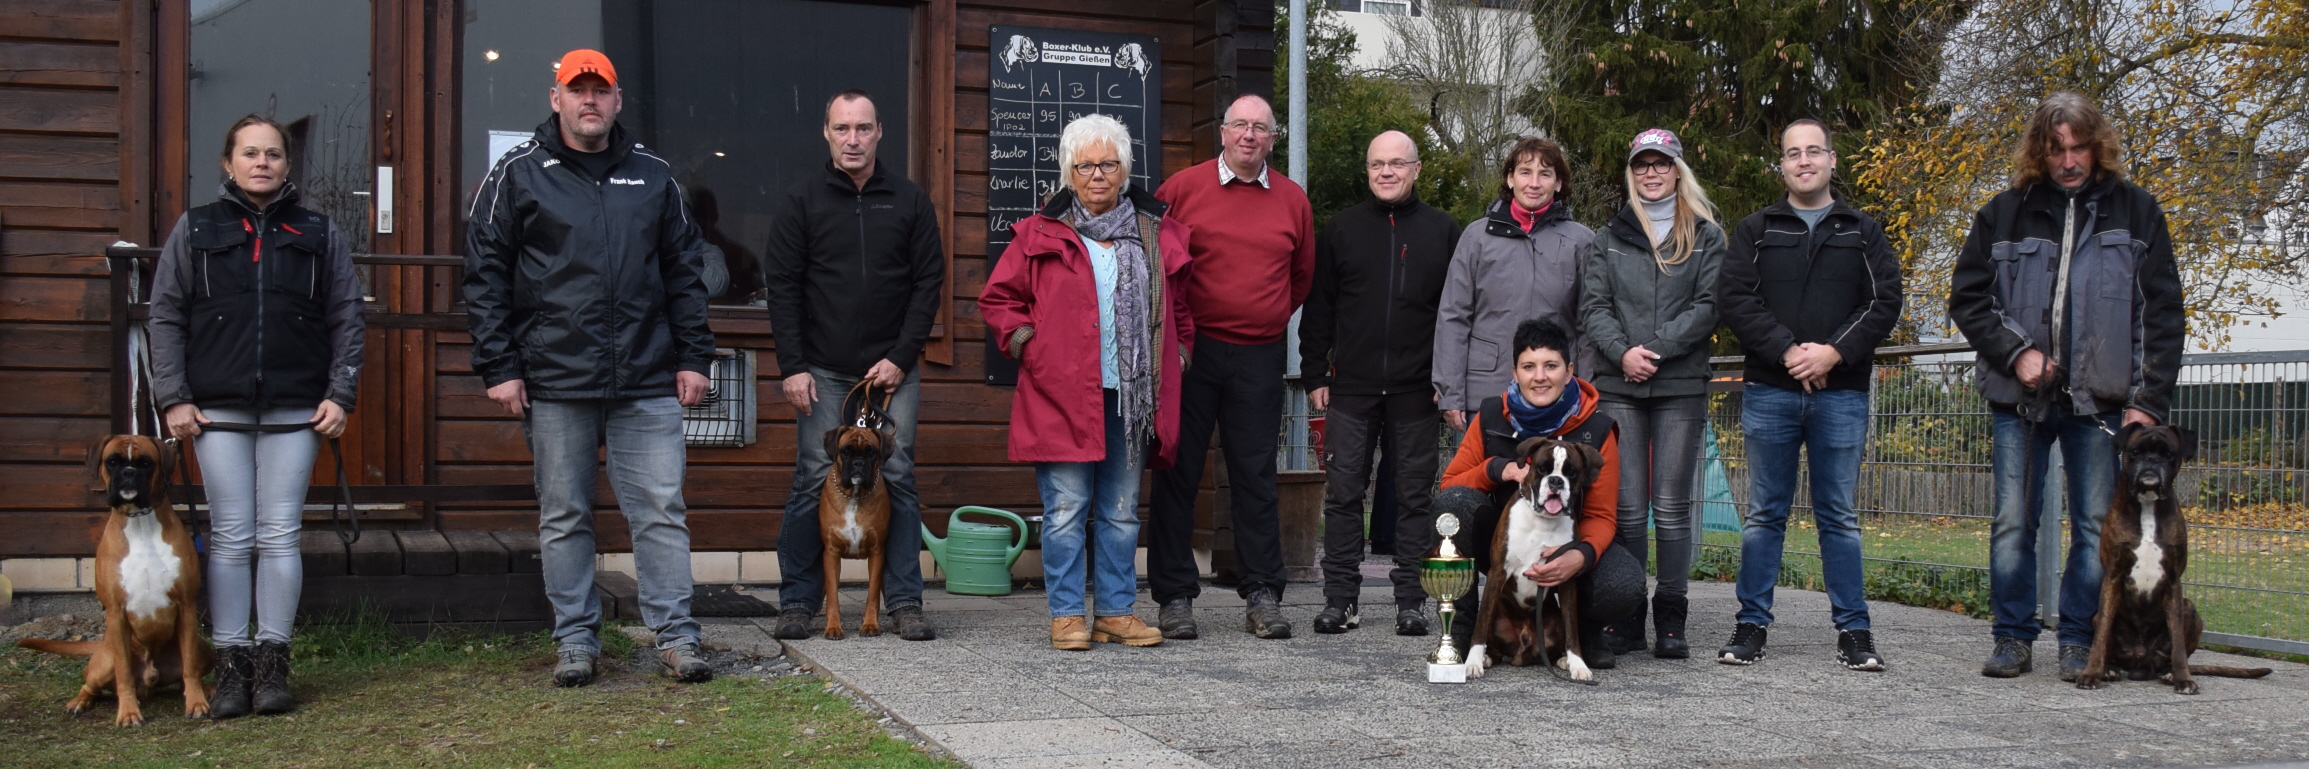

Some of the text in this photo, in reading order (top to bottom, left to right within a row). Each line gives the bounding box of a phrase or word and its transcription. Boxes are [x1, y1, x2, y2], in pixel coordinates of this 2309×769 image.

[1042, 41, 1111, 54] Boxer-Klub e.V.
[1043, 52, 1110, 64] Gruppe Gießen
[992, 79, 1025, 90] Name
[1039, 82, 1051, 97] A
[1068, 82, 1085, 98] B
[1107, 83, 1122, 98] C
[991, 107, 1032, 128] Spencer
[1040, 109, 1057, 122] 95
[543, 158, 561, 168] JAKO
